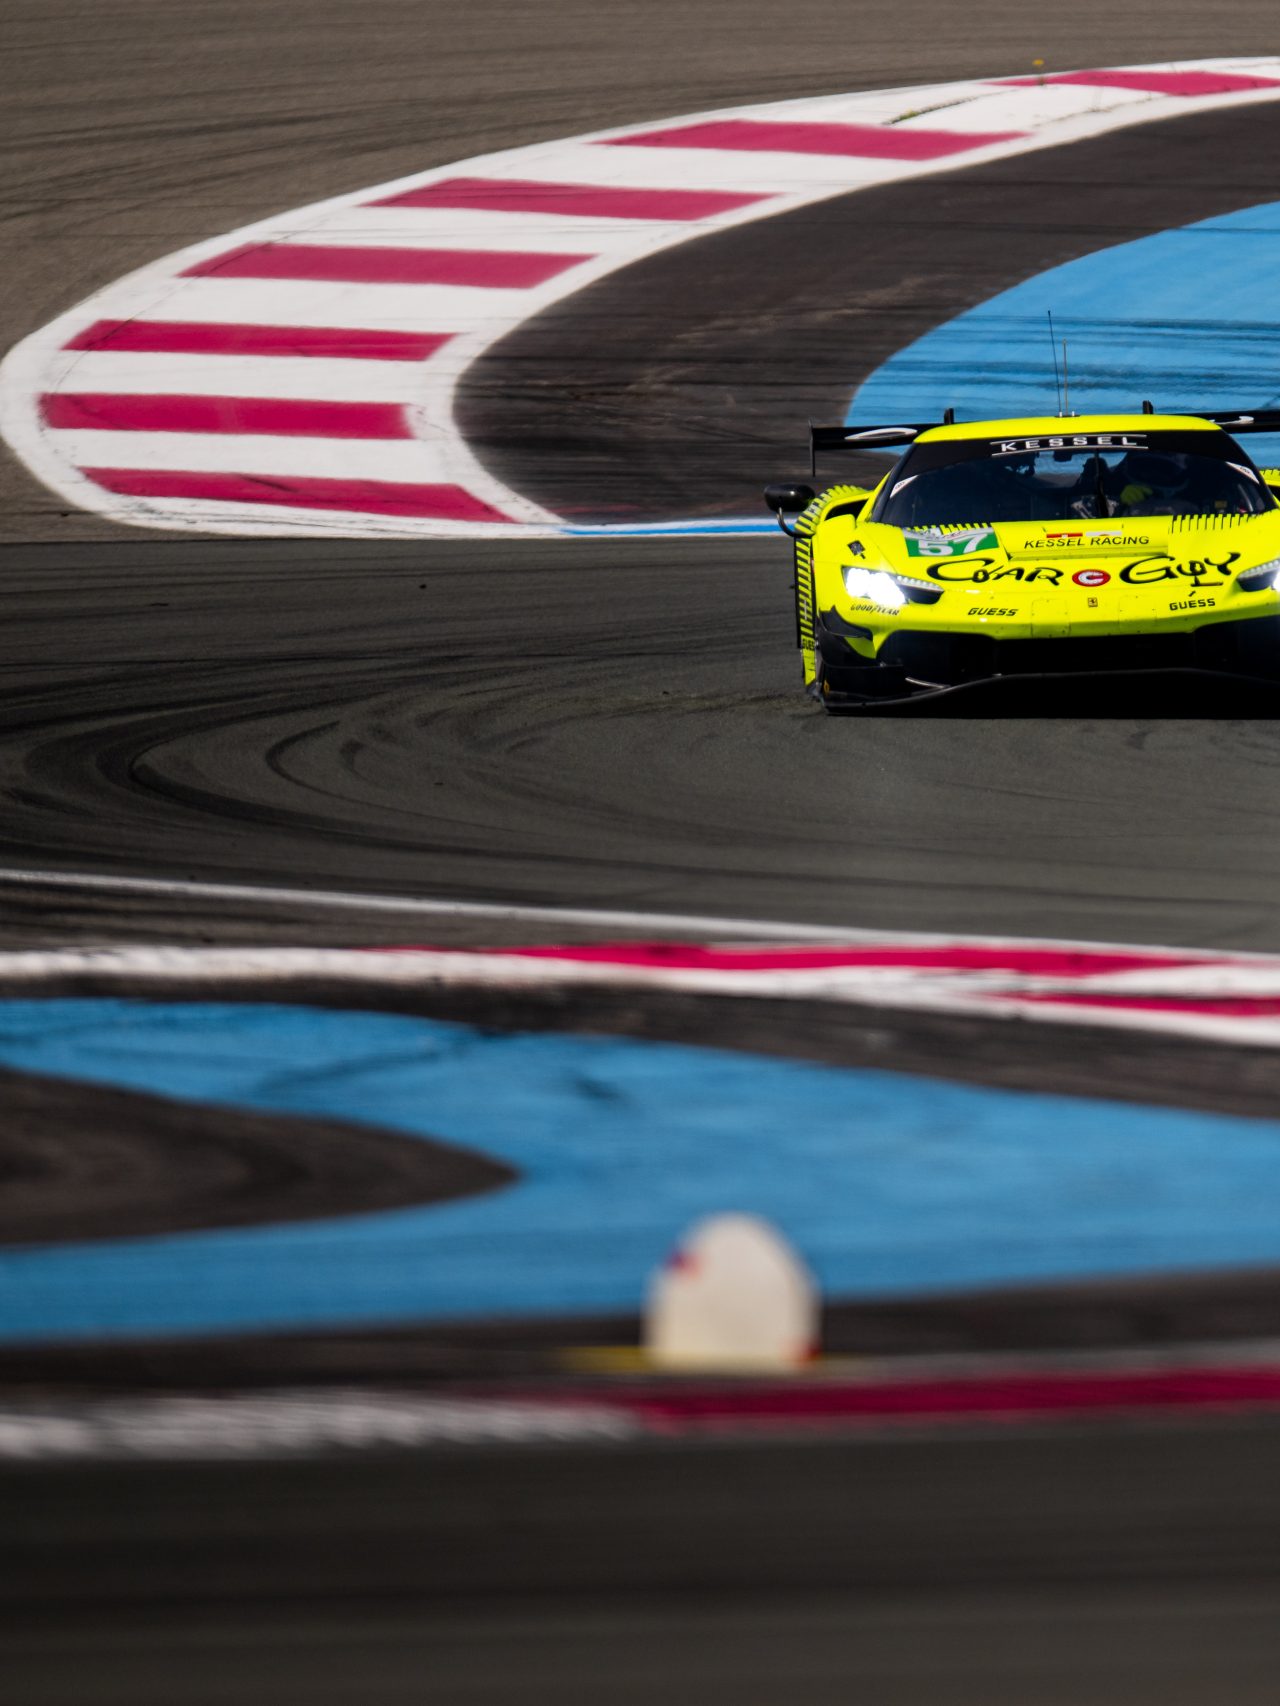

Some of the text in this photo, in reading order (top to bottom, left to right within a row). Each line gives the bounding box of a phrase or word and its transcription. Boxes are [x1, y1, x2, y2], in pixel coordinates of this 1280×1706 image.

[1000, 436, 1138, 452] KESSEL
[918, 533, 988, 556] 57
[1024, 536, 1150, 549] KESSEL RACING
[1169, 598, 1216, 611] GUESS
[967, 607, 1019, 617] GUESS
